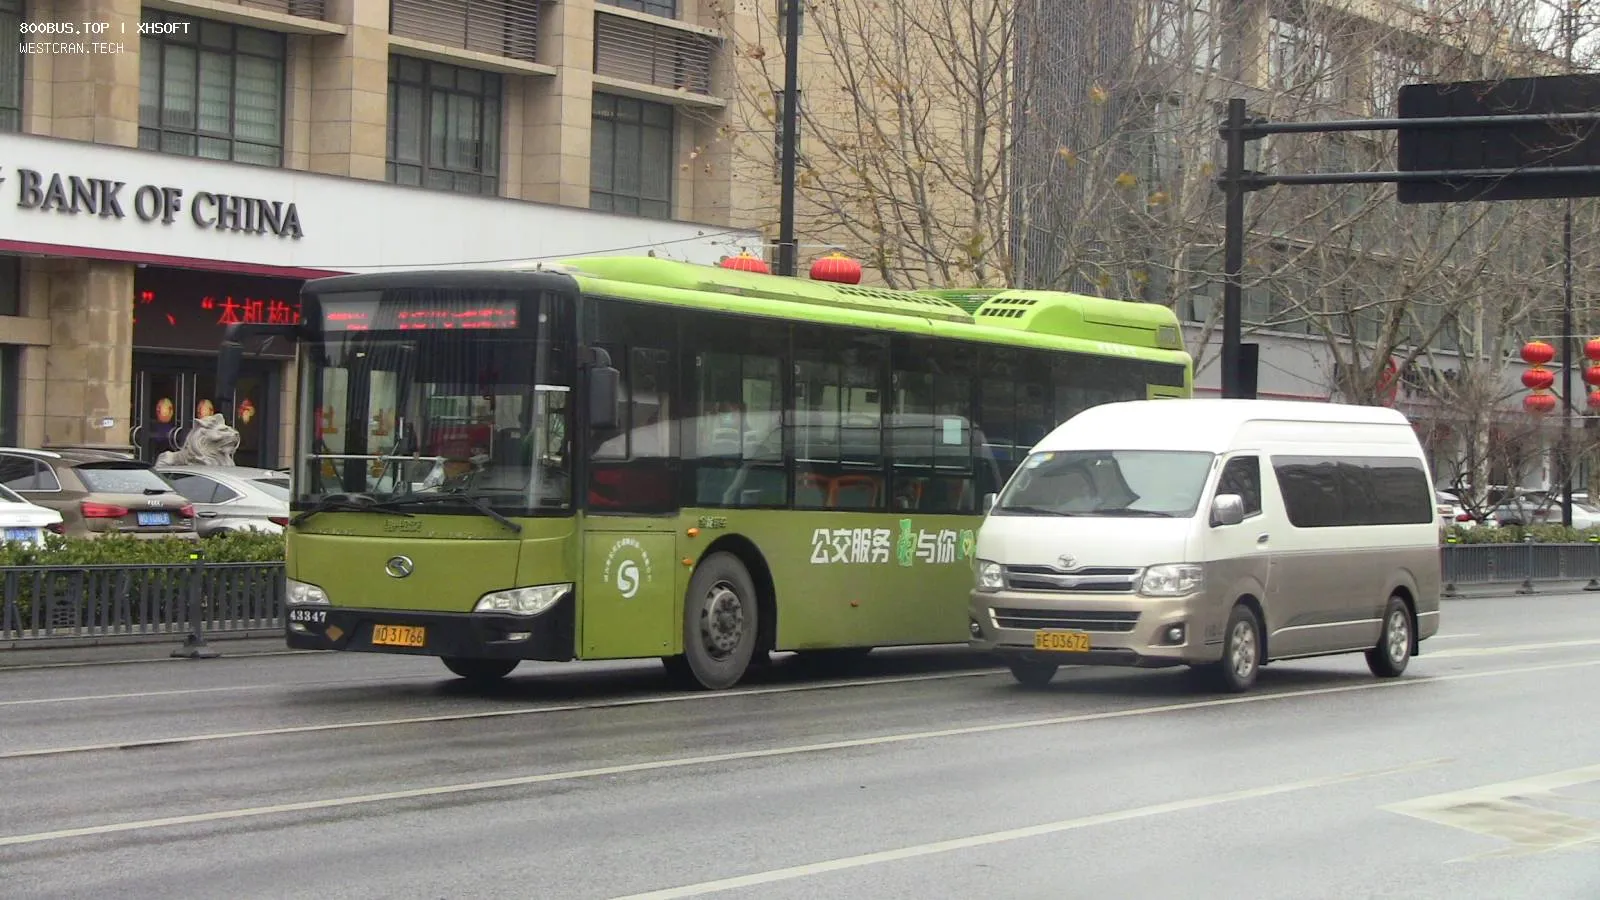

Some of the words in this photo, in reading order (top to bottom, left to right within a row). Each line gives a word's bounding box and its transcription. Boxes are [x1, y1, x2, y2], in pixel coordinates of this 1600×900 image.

[17, 168, 126, 218] BANK
[134, 184, 183, 225] OF
[191, 190, 304, 239] CHINA
[810, 528, 891, 564] 公交服务
[289, 609, 327, 622] 43347
